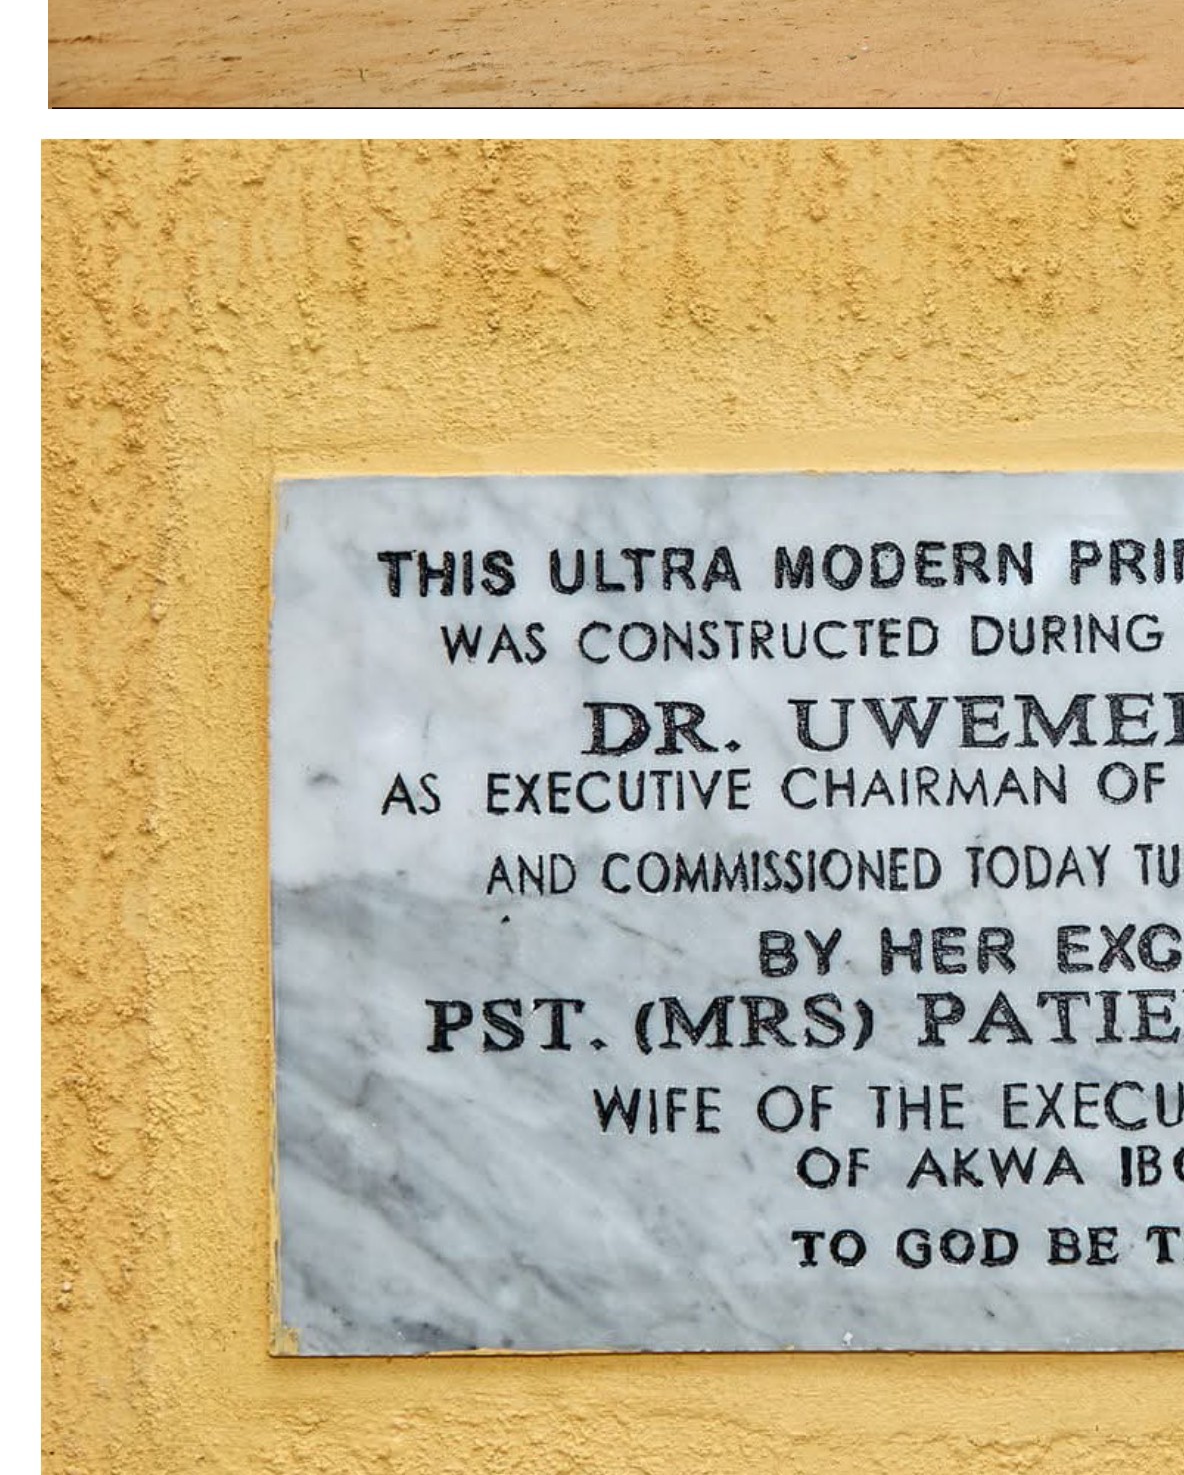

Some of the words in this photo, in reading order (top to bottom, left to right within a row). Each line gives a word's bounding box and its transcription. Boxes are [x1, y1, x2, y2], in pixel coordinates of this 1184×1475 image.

[377, 550, 516, 597] THIS
[550, 546, 741, 595] ULTRA
[775, 541, 1033, 591] MODERN
[441, 622, 547, 665] WAS
[578, 617, 938, 664] CONSTRUCTED
[971, 613, 1164, 656] DURING
[581, 701, 741, 757] DR.
[382, 773, 440, 815] AS
[487, 768, 750, 815] EXECUTIVE
[781, 764, 1066, 809] CHAIRMAN
[1097, 762, 1165, 805] OF
[487, 854, 576, 896] AND
[602, 848, 941, 893] COMMISSIONED
[966, 844, 1110, 890] TODAY
[759, 928, 841, 978] BY
[881, 927, 1016, 976] HER
[425, 998, 607, 1053] PST.
[635, 993, 873, 1055] (MRS)
[593, 1085, 720, 1134] WIFE
[757, 1085, 833, 1133] OF
[868, 1083, 964, 1131] THE
[797, 1147, 869, 1189] OF
[907, 1146, 1084, 1189] AKWA
[791, 1229, 866, 1267] TO
[897, 1228, 1018, 1269] GOD
[1048, 1227, 1119, 1266] BE
